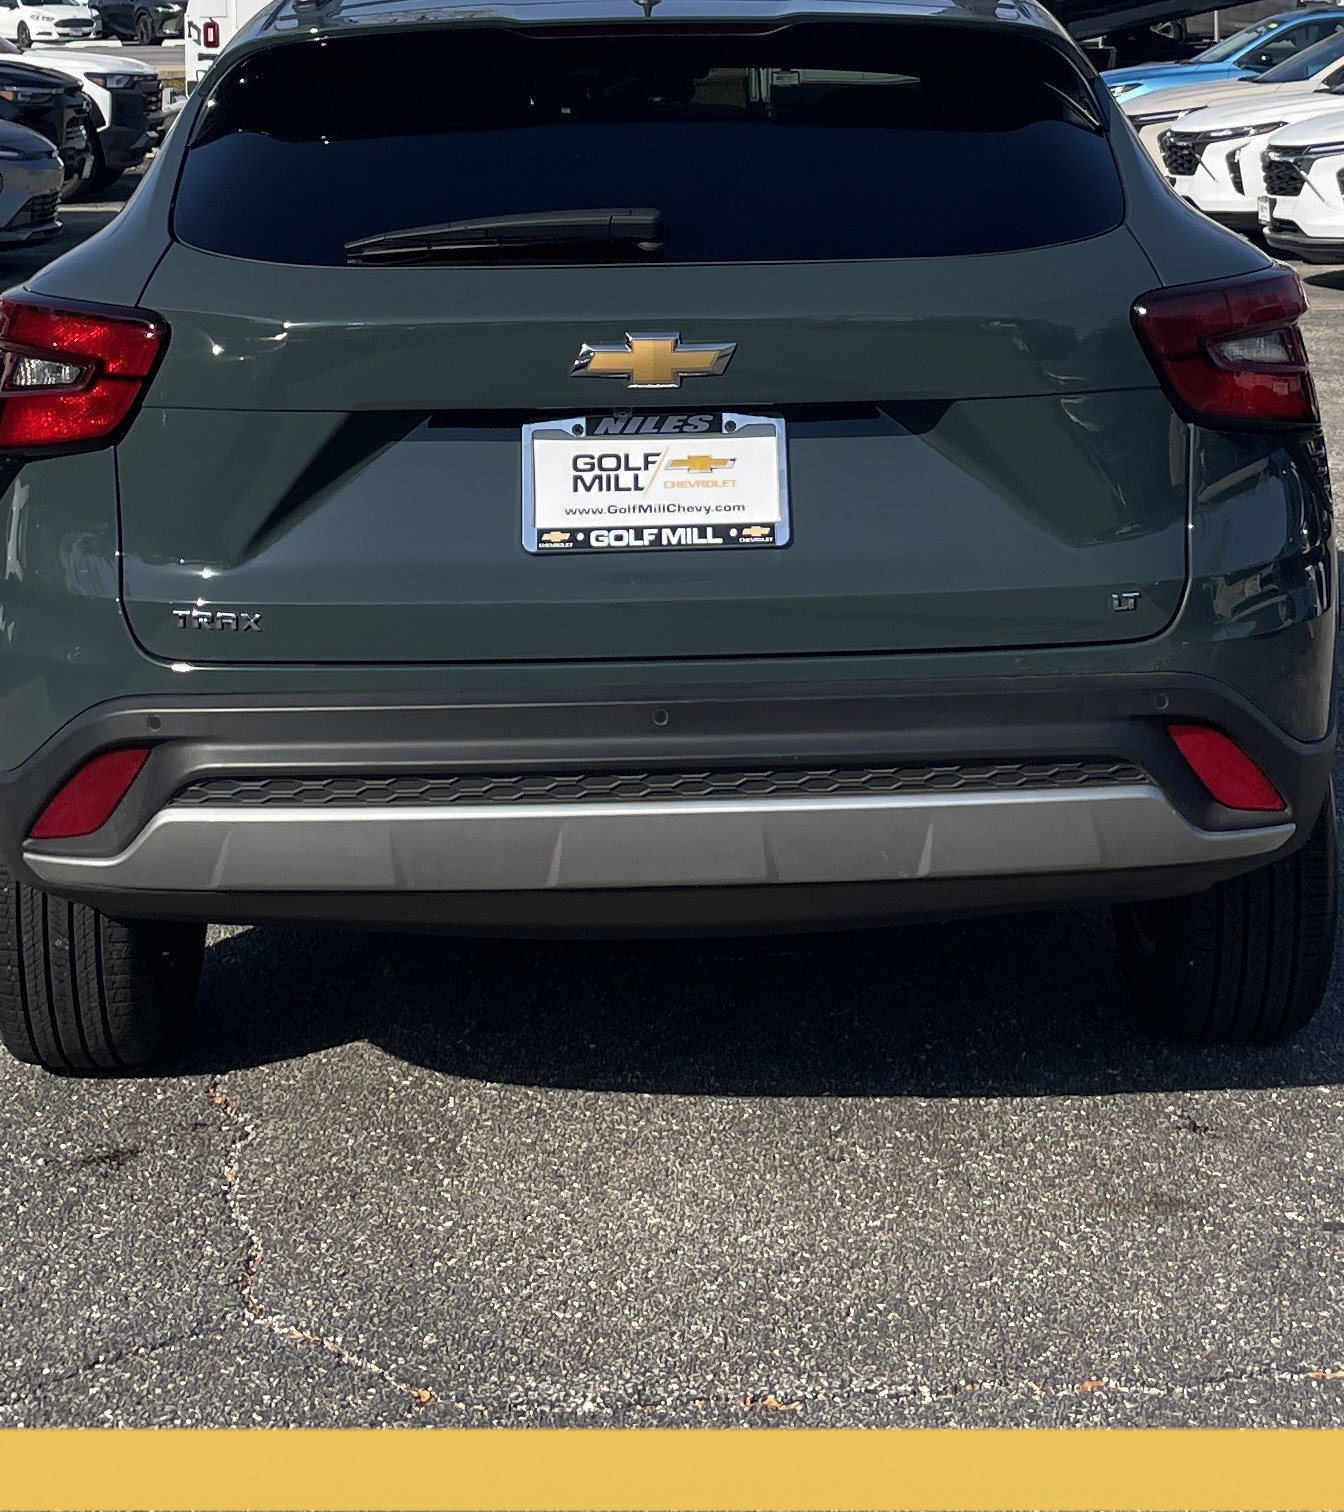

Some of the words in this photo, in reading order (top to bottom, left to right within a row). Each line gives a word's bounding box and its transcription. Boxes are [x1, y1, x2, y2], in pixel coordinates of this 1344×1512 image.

[593, 414, 713, 435] NILES
[571, 452, 662, 473] GOLF
[572, 473, 646, 493] MILL
[663, 479, 738, 489] CHEVROLET
[564, 503, 746, 516] www.GolfMillChevy.com
[590, 529, 658, 547] GOLF
[661, 527, 723, 546] MILL
[172, 609, 263, 632] TRAX
